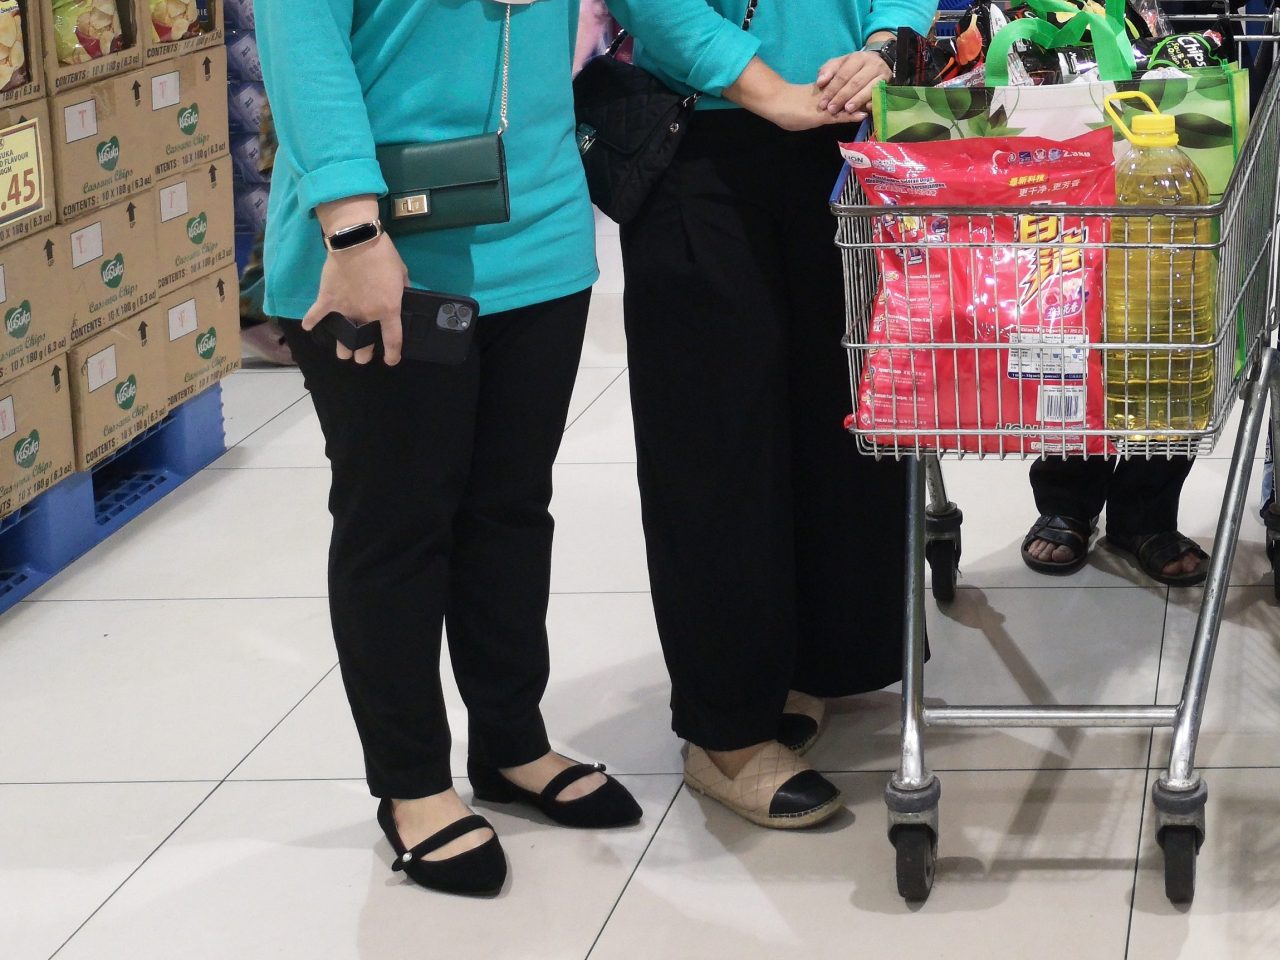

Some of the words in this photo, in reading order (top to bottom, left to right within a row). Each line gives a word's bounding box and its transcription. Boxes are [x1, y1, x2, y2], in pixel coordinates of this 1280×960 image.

[1177, 36, 1207, 68] Chips
[4, 152, 29, 166] FLAVOUR
[114, 168, 133, 181] Chips
[119, 284, 138, 298] Chips
[25, 332, 46, 349] Chips
